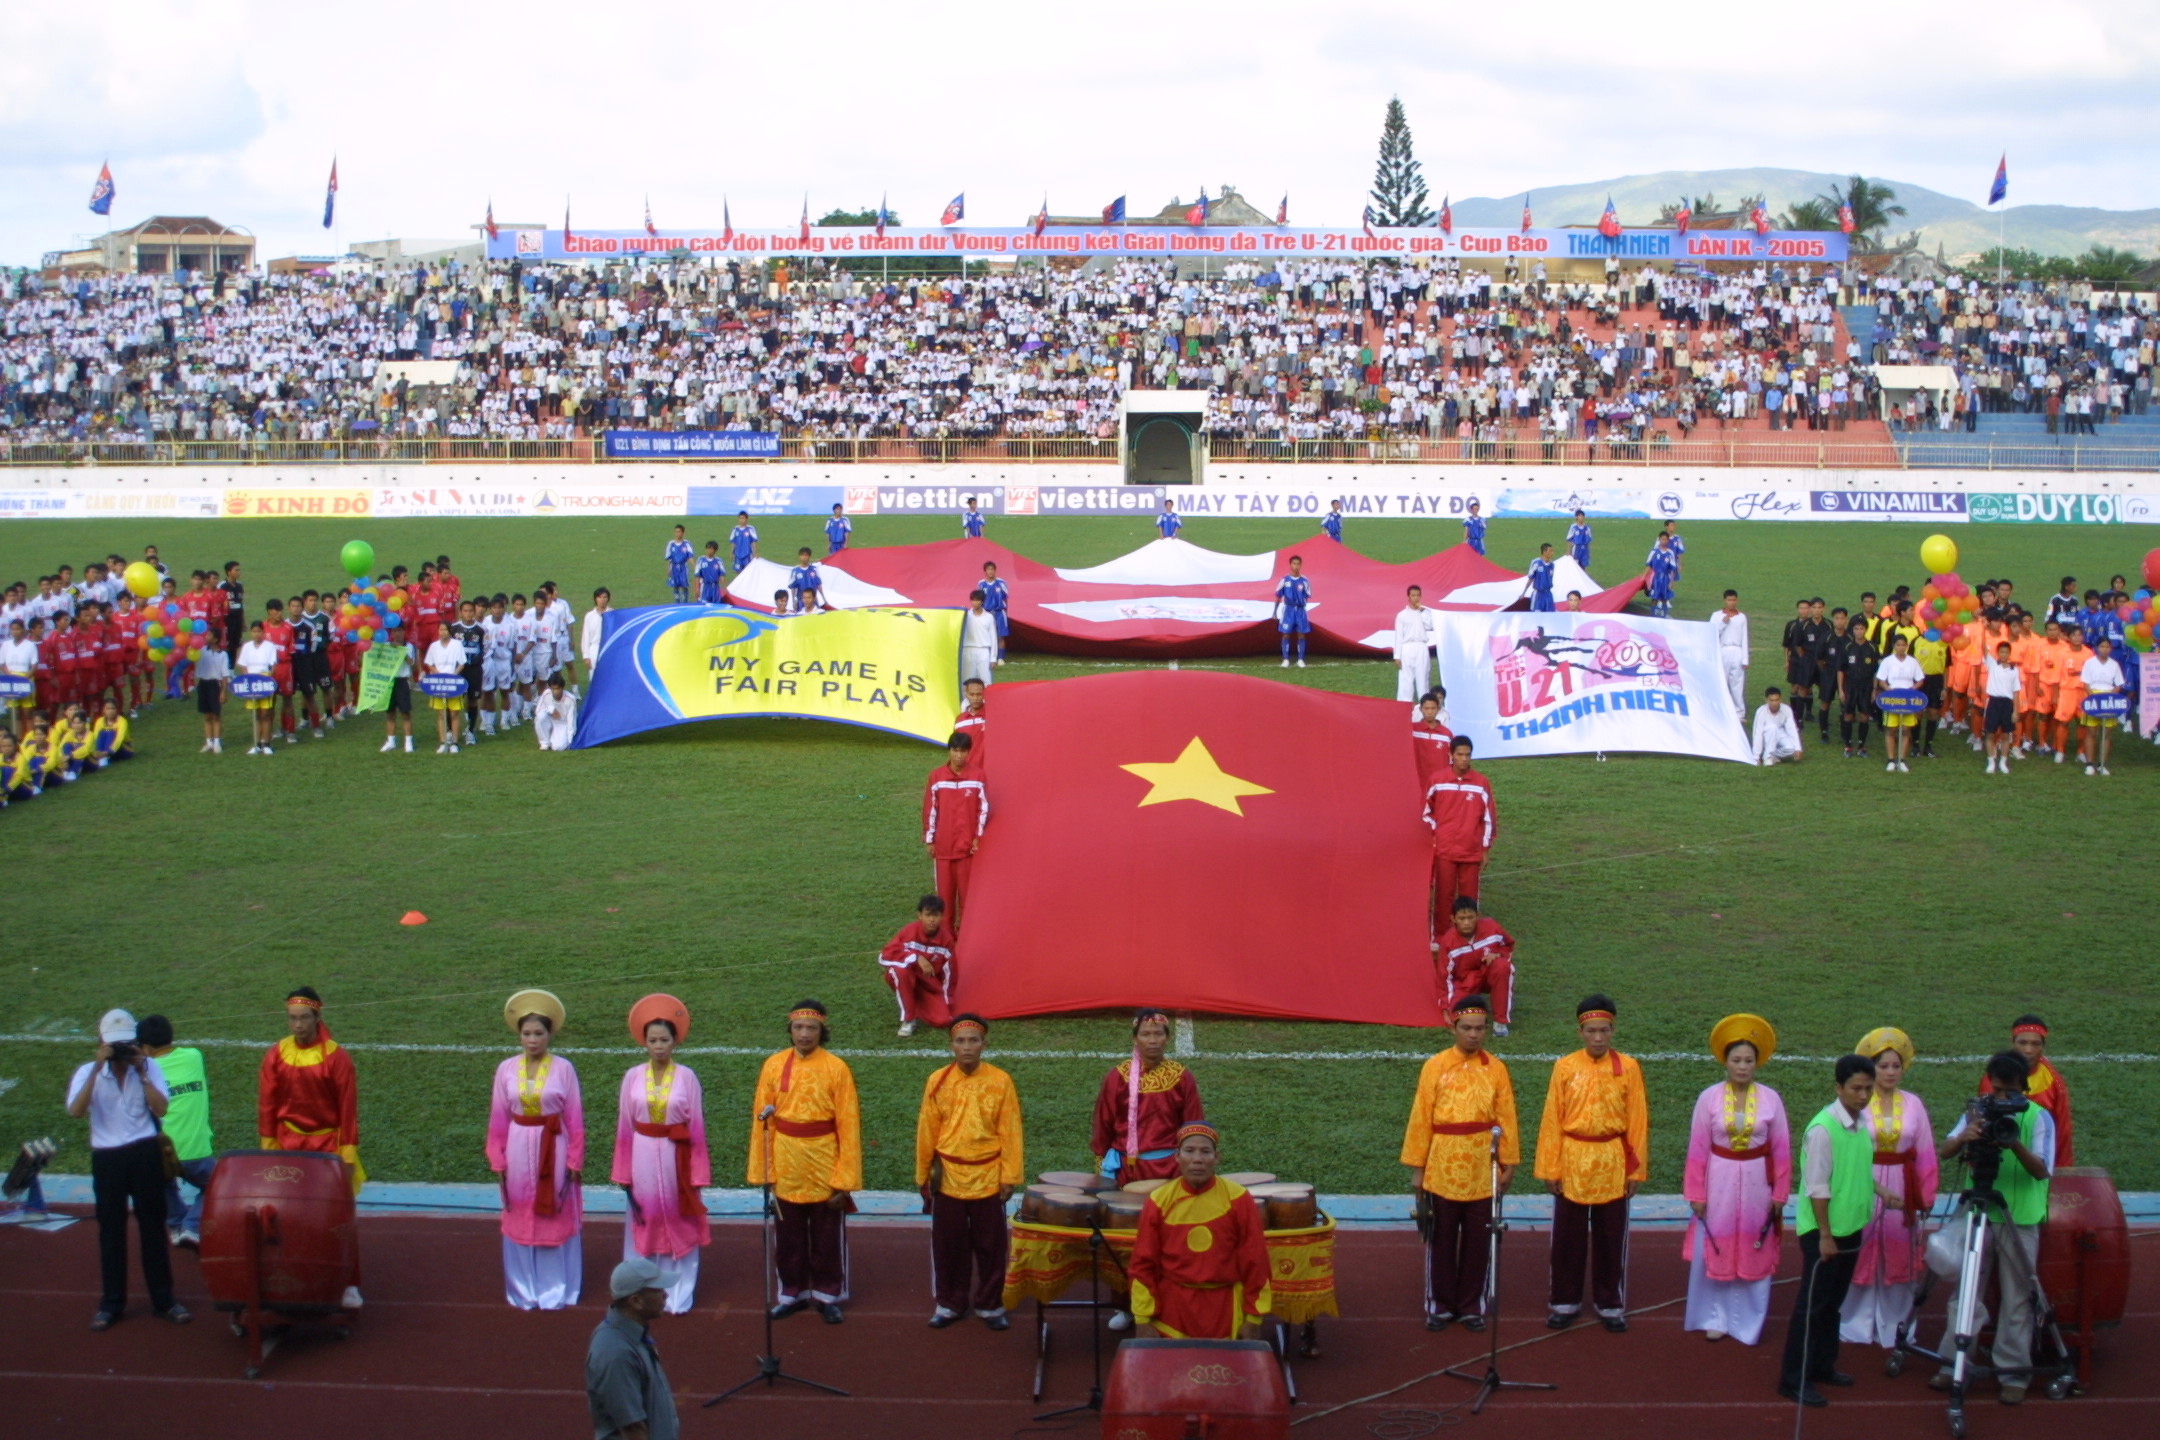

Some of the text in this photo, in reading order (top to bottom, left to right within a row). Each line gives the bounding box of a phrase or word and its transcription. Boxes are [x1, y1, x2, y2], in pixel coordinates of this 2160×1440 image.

[1301, 234, 1346, 250] U-21
[1410, 234, 1443, 253] gia
[1567, 234, 1627, 255] THANH
[1731, 239, 1751, 256] IX
[1767, 239, 1825, 256] 2005
[256, 497, 325, 514] KINH
[332, 493, 370, 514] ĐÔ
[411, 489, 464, 505] SUN
[647, 496, 683, 507] AUTO
[737, 488, 793, 505] ANZ
[1177, 491, 1319, 514] MAY TÂY ĐÔ
[1339, 495, 1389, 513] MAY
[1397, 492, 1442, 514] TÂY
[1846, 492, 1958, 512] VINAMILK
[2016, 494, 2076, 521] DUY
[709, 656, 926, 693] MY GAME IS
[716, 676, 914, 711] FAIR PLAY
[1496, 693, 1606, 741] THANH
